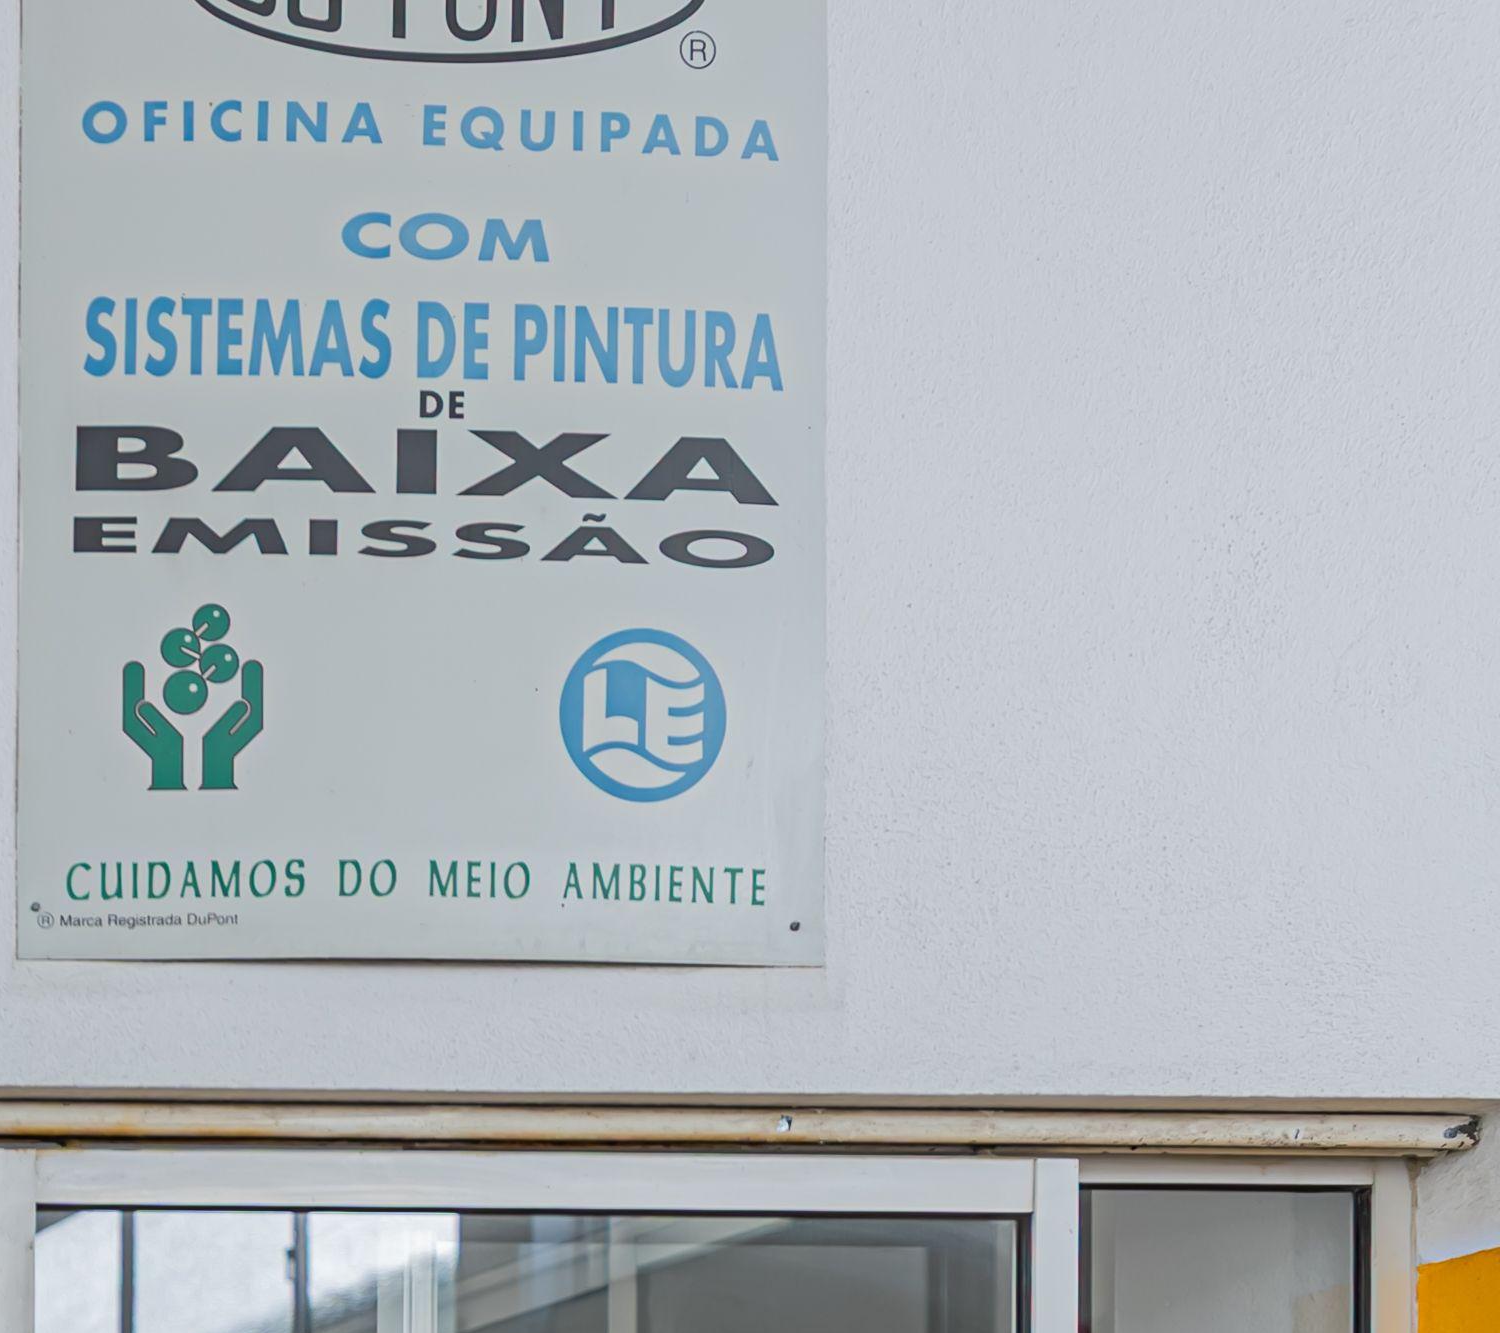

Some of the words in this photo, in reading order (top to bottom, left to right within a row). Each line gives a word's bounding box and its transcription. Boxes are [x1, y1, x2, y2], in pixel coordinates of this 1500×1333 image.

[82, 99, 383, 145] OFICINA
[423, 105, 780, 162] EQUIPADA
[341, 212, 550, 263] COM
[84, 295, 391, 380] SISTEMAS
[417, 301, 488, 380] DE
[514, 303, 783, 392] PINTURA
[419, 391, 465, 420] DE
[76, 425, 779, 506] BAIXA
[73, 512, 775, 569] EMISSÃO
[66, 858, 305, 902] CUIDAMOS
[339, 859, 397, 898] DO
[429, 861, 530, 900] MEIO
[562, 862, 767, 907] AMBIENTE
[60, 915, 102, 927] Marca
[108, 914, 181, 929] Registrada
[187, 913, 238, 925] DuPont
